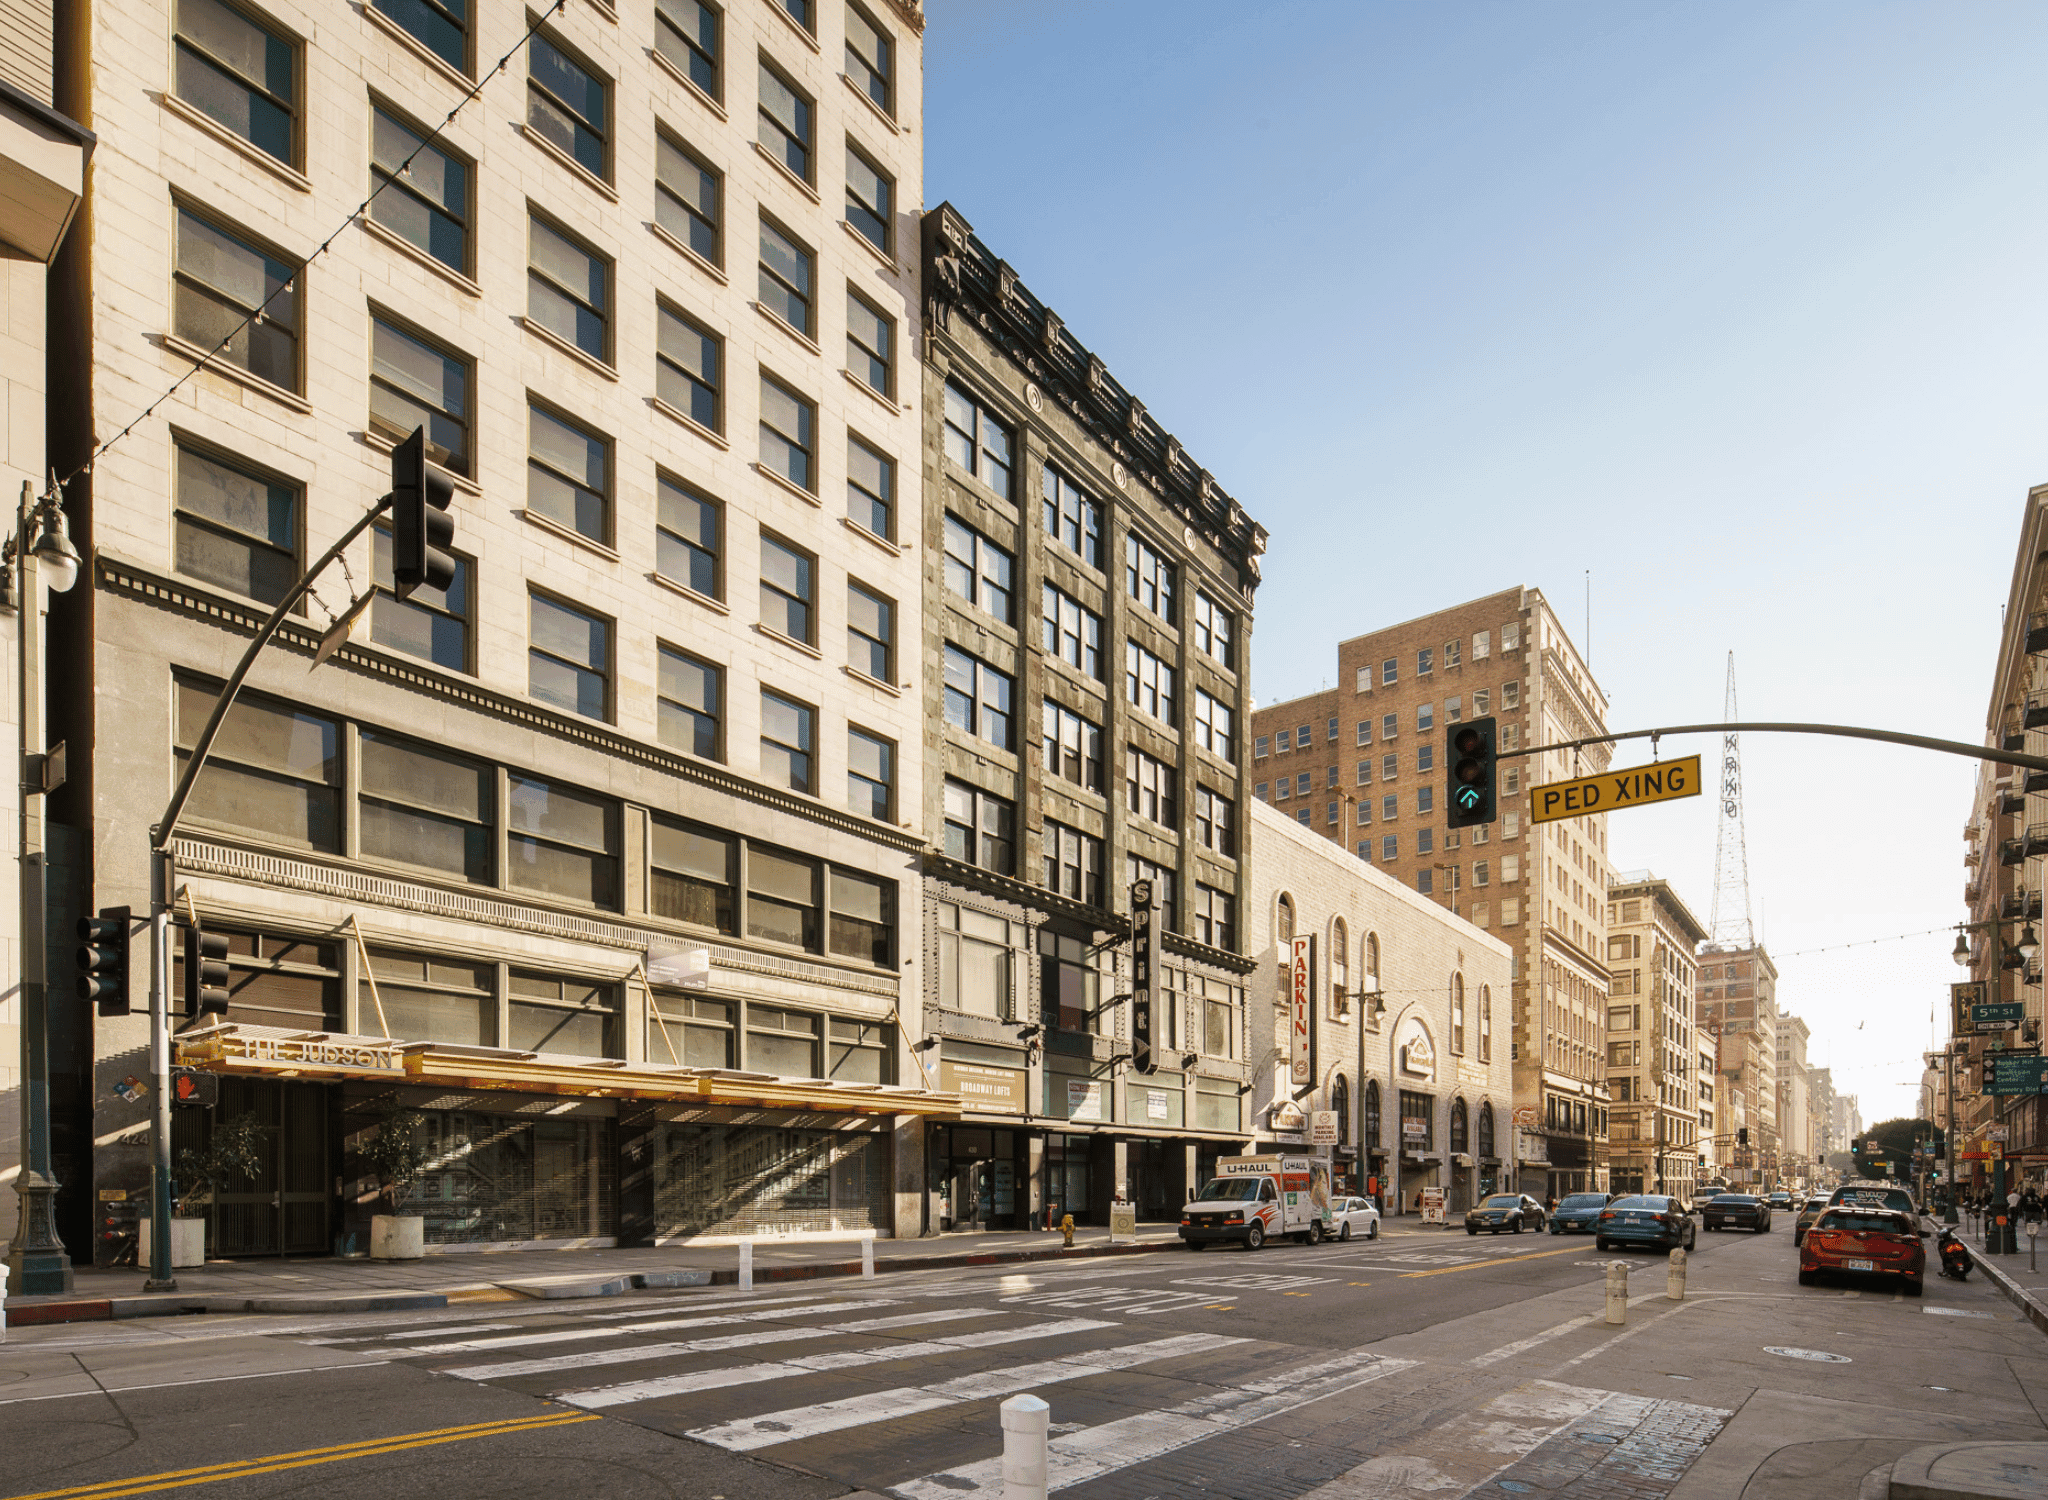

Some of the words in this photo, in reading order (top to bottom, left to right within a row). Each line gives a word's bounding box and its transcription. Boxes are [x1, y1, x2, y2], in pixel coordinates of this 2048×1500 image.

[1544, 783, 1600, 815] PED
[1615, 766, 1685, 802] XING
[1294, 941, 1307, 1051] PARKIN
[1979, 1008, 1999, 1018] 5th
[241, 1039, 286, 1061] THE
[296, 1043, 392, 1069] JUDSON
[960, 1081, 993, 1095] BROADWAY
[993, 1085, 1010, 1097] LOFTS
[121, 1132, 150, 1145] 424
[1227, 1163, 1272, 1174] U-HAUL
[1284, 1161, 1307, 1171] U-HAUL
